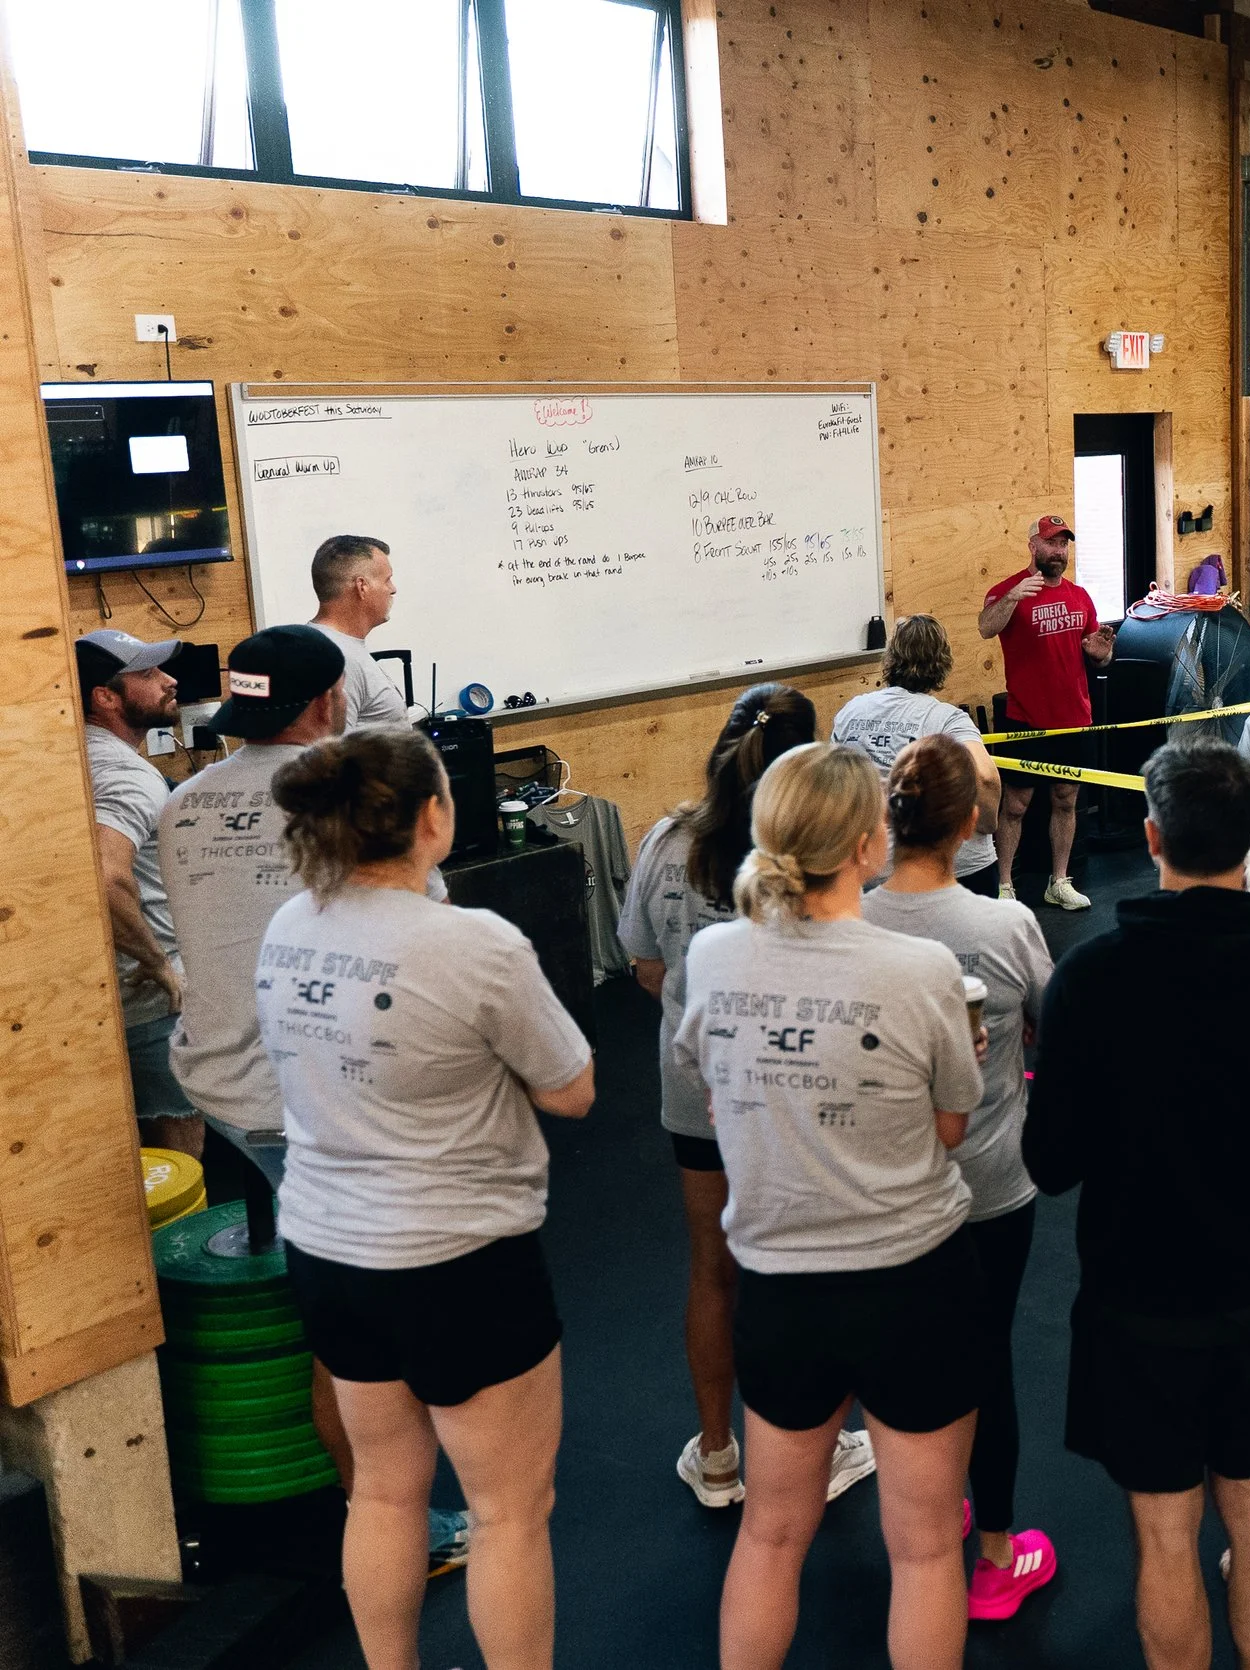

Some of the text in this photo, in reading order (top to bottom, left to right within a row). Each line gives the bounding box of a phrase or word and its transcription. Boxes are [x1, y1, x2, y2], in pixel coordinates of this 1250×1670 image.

[1122, 334, 1145, 366] EXIT
[324, 405, 343, 416] this
[345, 403, 382, 416] Saturday
[508, 438, 537, 458] Hero
[323, 460, 336, 475] Up
[710, 454, 718, 465] 10
[506, 488, 518, 502] 13
[688, 488, 711, 513] 12/9
[507, 505, 523, 519] 23
[511, 521, 519, 535] 9
[513, 539, 523, 551] 17
[693, 541, 702, 564] 8
[522, 558, 535, 570] the
[538, 558, 551, 568] end
[564, 554, 577, 567] the
[548, 572, 569, 583] break
[1032, 603, 1069, 623] EUREKA
[1039, 613, 1085, 633] CROSSFIT
[849, 718, 920, 735] EVENT STAFF
[180, 791, 245, 810] EVENT
[321, 952, 399, 986] STAFF
[708, 990, 881, 1028] EVENT STAFF
[744, 1068, 838, 1092] THICCBOI
